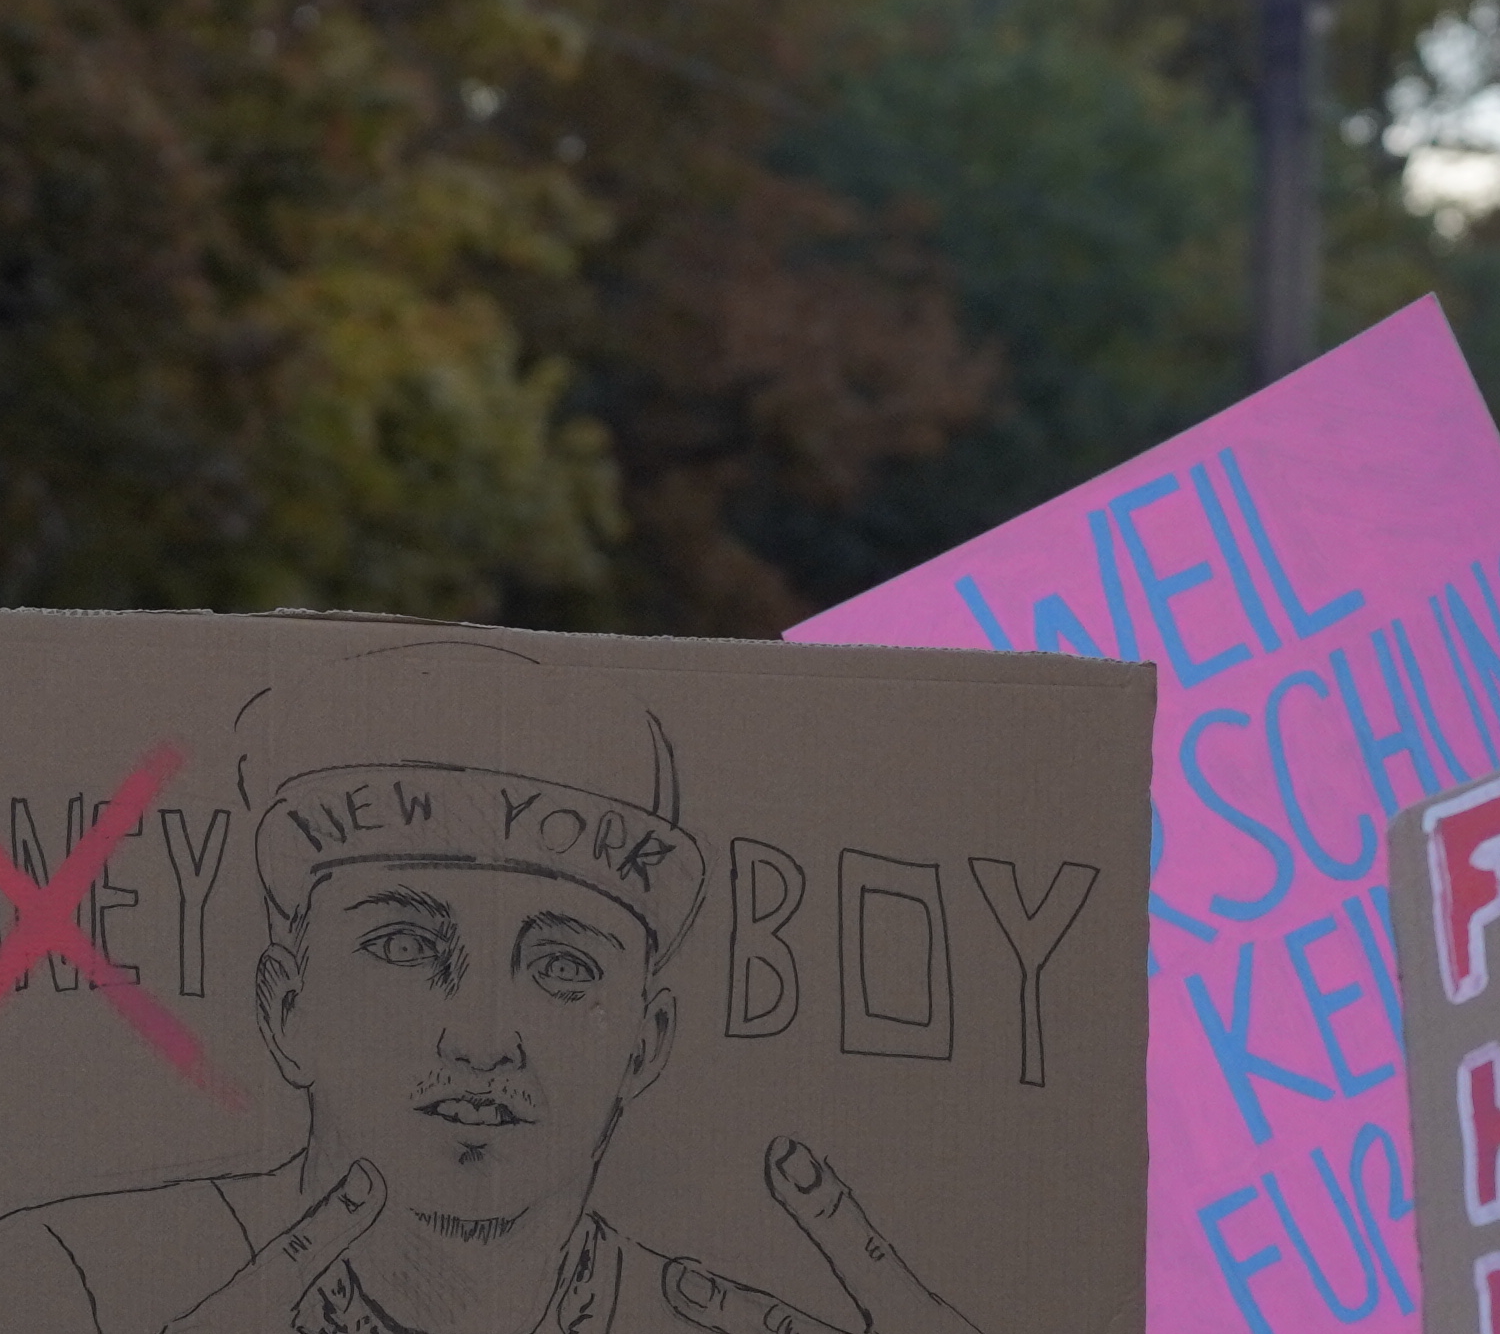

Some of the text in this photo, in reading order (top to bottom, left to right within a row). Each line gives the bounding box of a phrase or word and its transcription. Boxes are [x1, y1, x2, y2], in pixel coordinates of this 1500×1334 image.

[287, 779, 677, 893] NEW YORK
[725, 837, 1100, 1088] BOY
[1183, 885, 1407, 1147] KEI
